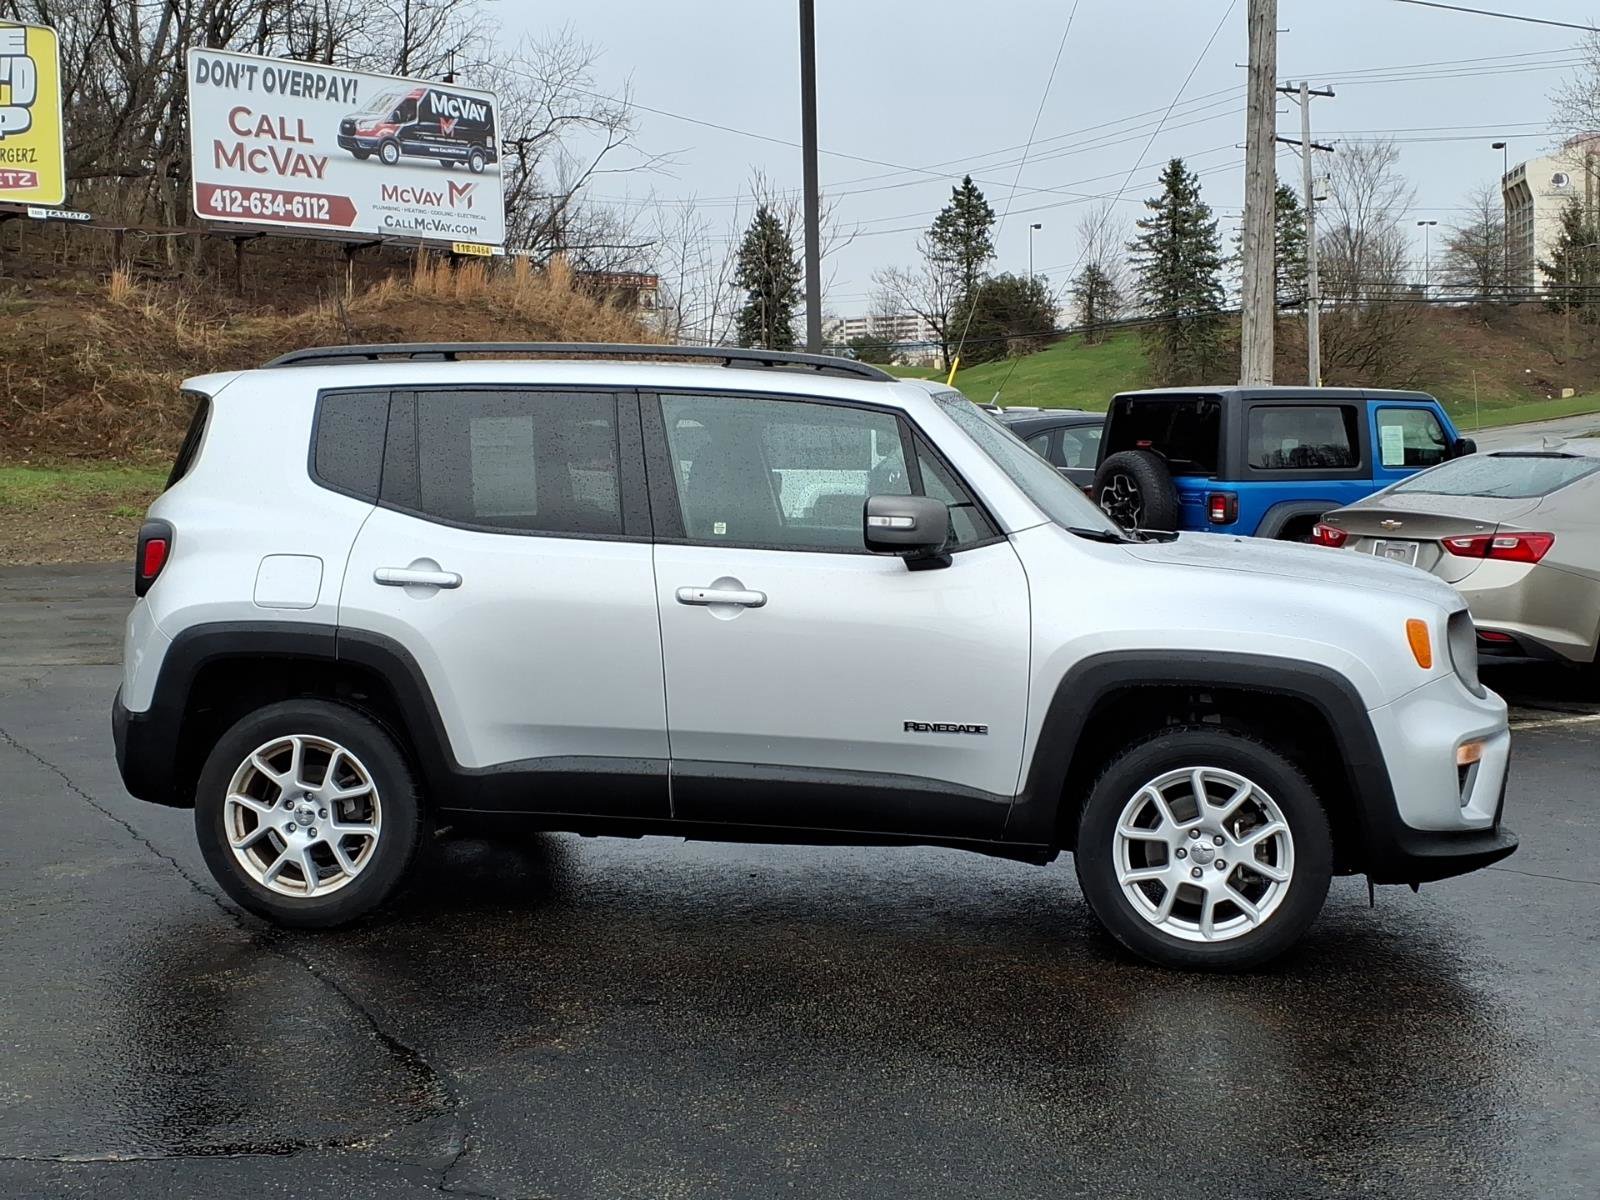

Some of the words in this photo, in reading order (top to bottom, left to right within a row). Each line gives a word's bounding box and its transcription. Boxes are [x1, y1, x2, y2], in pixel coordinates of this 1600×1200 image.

[196, 57, 258, 91] DON'T
[262, 67, 358, 104] OVERPAY!
[228, 106, 314, 144] CALL
[210, 188, 330, 220] 412-634-6112
[372, 204, 400, 212] PLUMBING
[404, 207, 427, 215] HEATING
[457, 212, 487, 221] ELECTRICAL
[903, 721, 988, 735] RENEGADE
